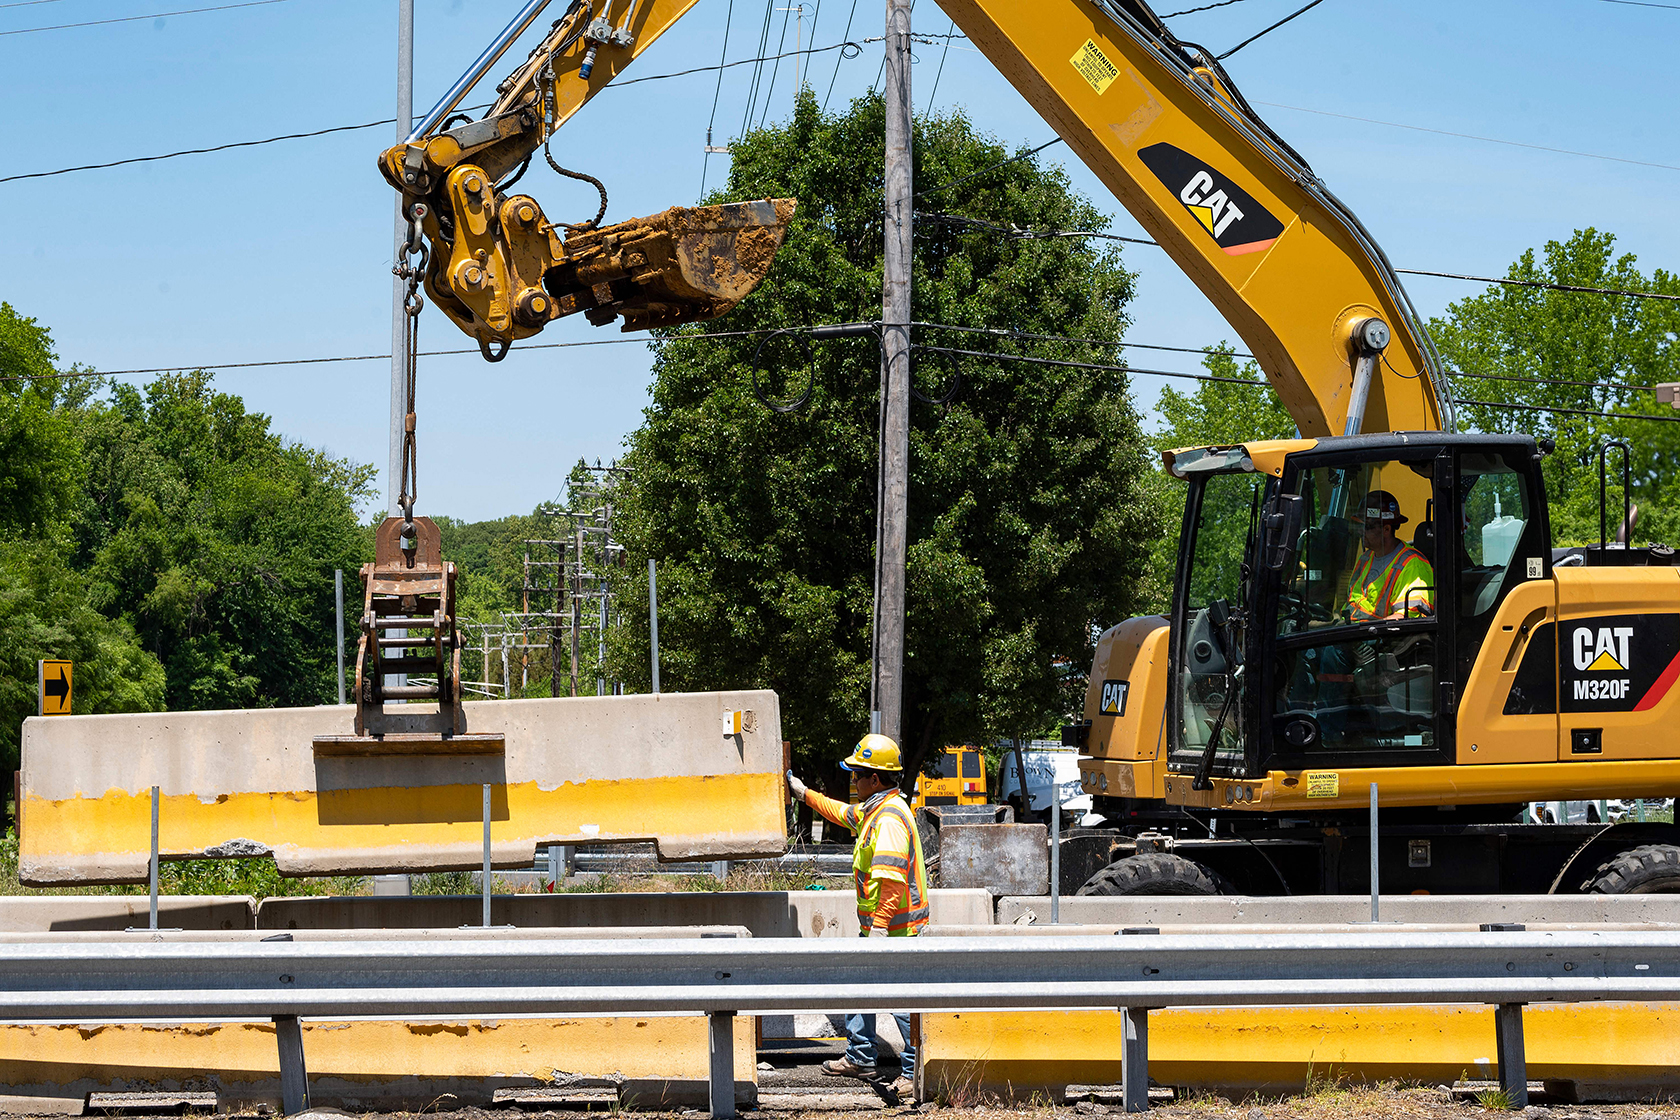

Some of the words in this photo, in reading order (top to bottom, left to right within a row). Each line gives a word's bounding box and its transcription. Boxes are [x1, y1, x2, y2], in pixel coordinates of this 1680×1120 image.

[1087, 41, 1118, 77] WARNING
[1180, 170, 1245, 239] CAT
[1529, 566, 1536, 576] 99
[1573, 627, 1634, 671] CAT
[1101, 683, 1127, 713] CAT
[1574, 679, 1630, 700] M320F
[1010, 766, 1054, 779] BOWN
